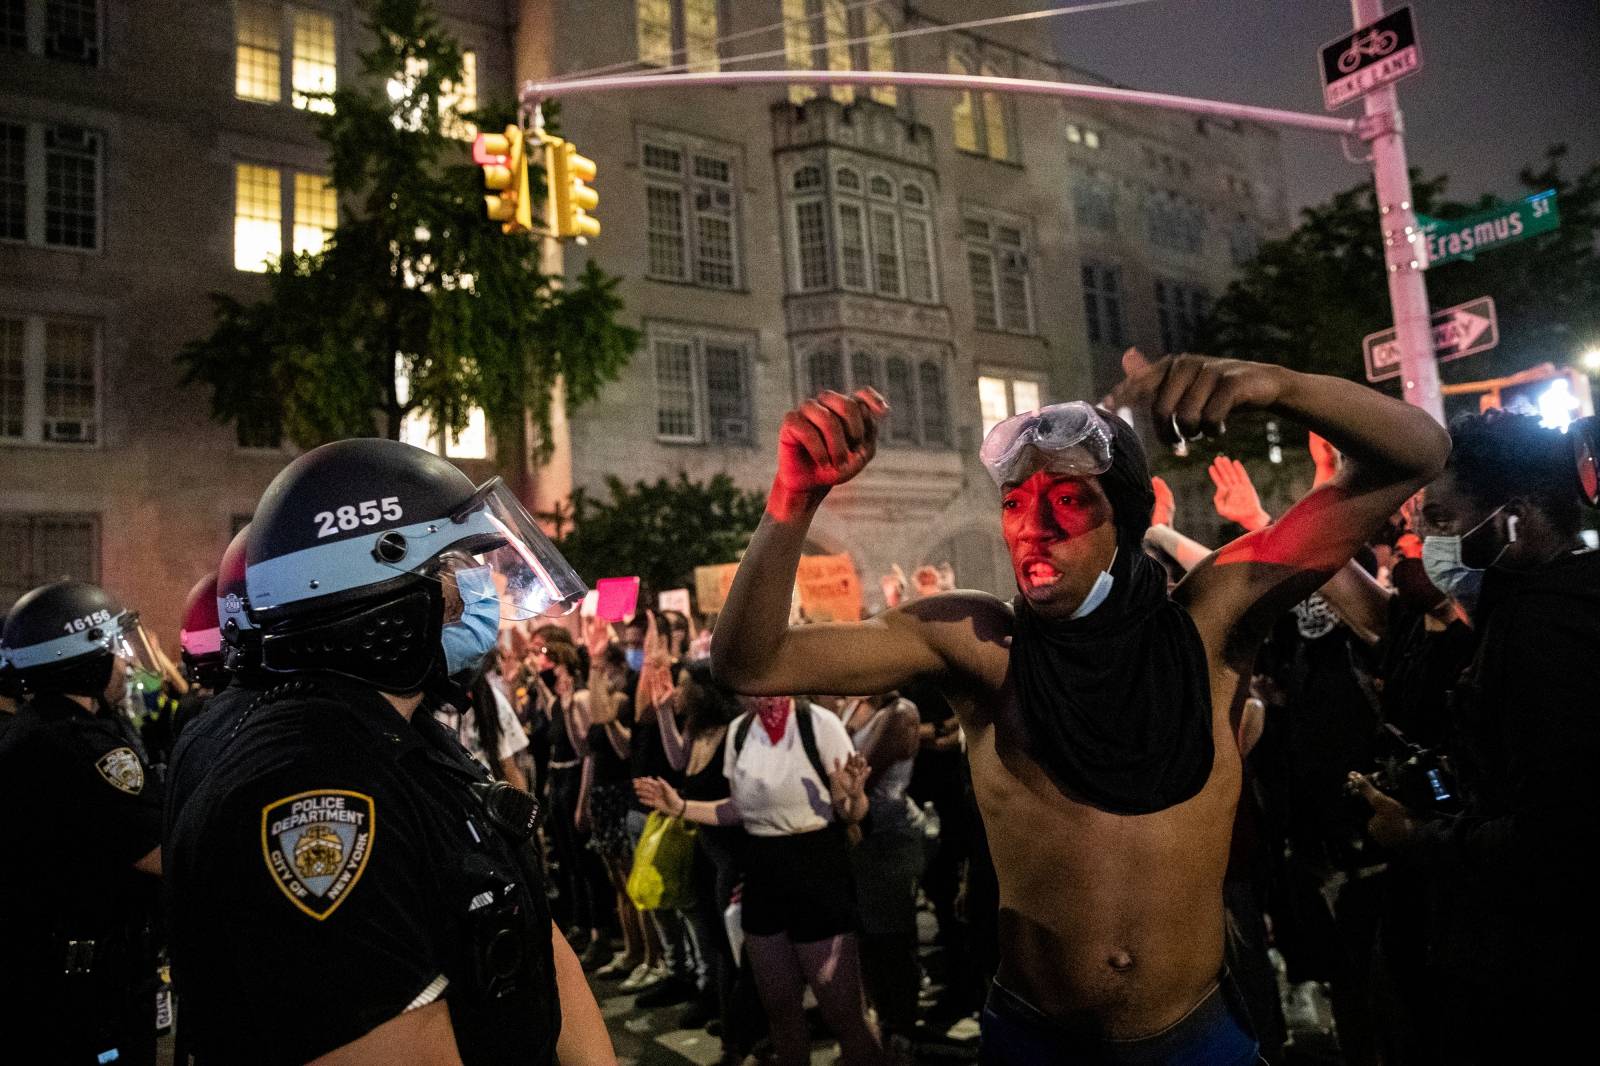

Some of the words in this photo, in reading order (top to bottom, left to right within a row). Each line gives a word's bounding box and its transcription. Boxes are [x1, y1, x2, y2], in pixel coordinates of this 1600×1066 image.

[1370, 53, 1413, 82] LANE
[1425, 211, 1524, 262] Erasmus
[313, 496, 404, 539] 2855
[63, 608, 111, 634] 16156
[271, 809, 366, 836] DEPARTMENT
[291, 796, 345, 815] POLICE
[271, 849, 293, 880] CITY
[289, 880, 309, 898] OF
[326, 869, 353, 901] NEW
[347, 831, 369, 870] YORK
